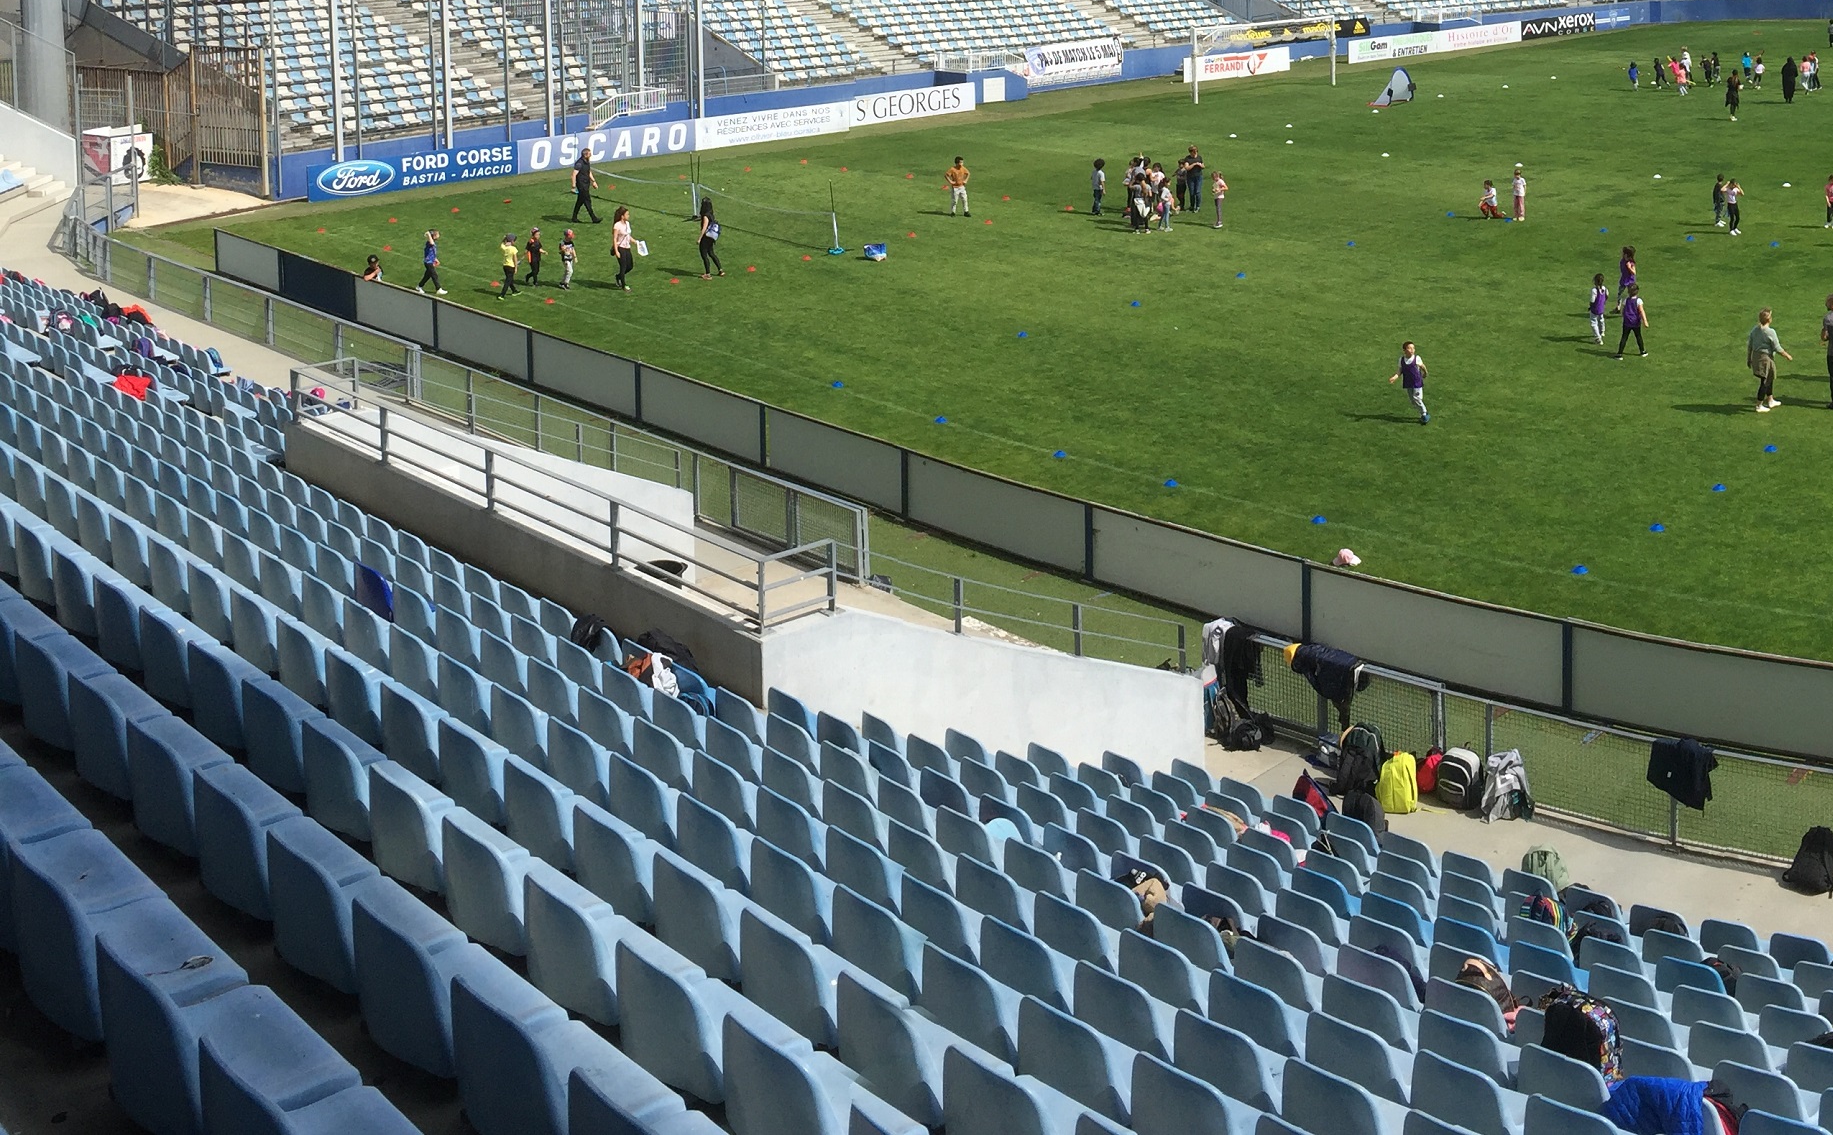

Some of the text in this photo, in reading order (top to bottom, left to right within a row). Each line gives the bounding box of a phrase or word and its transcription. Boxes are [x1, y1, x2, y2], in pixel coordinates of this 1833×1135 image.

[1522, 20, 1558, 36] AVN
[1558, 12, 1594, 28] xerox
[1448, 28, 1489, 42] Histoire
[1492, 24, 1513, 37] d'Or
[1558, 26, 1594, 36] CORSE
[1037, 44, 1116, 69] PAS DE MATCH LE 5 MAI
[1398, 44, 1428, 57] ENTRETIEN
[1204, 62, 1244, 74] FERRANDI
[872, 87, 961, 119] GEORGES
[716, 106, 830, 127] VENEZ VIVRE DANS NOS
[770, 118, 792, 129] AVEC
[794, 115, 831, 126] SERVICES
[530, 122, 688, 170] OSCARO
[402, 146, 514, 172] FORD CORSE
[332, 166, 380, 191] Ford
[402, 172, 446, 186] BASTIA
[461, 164, 512, 179] AJACCIO
